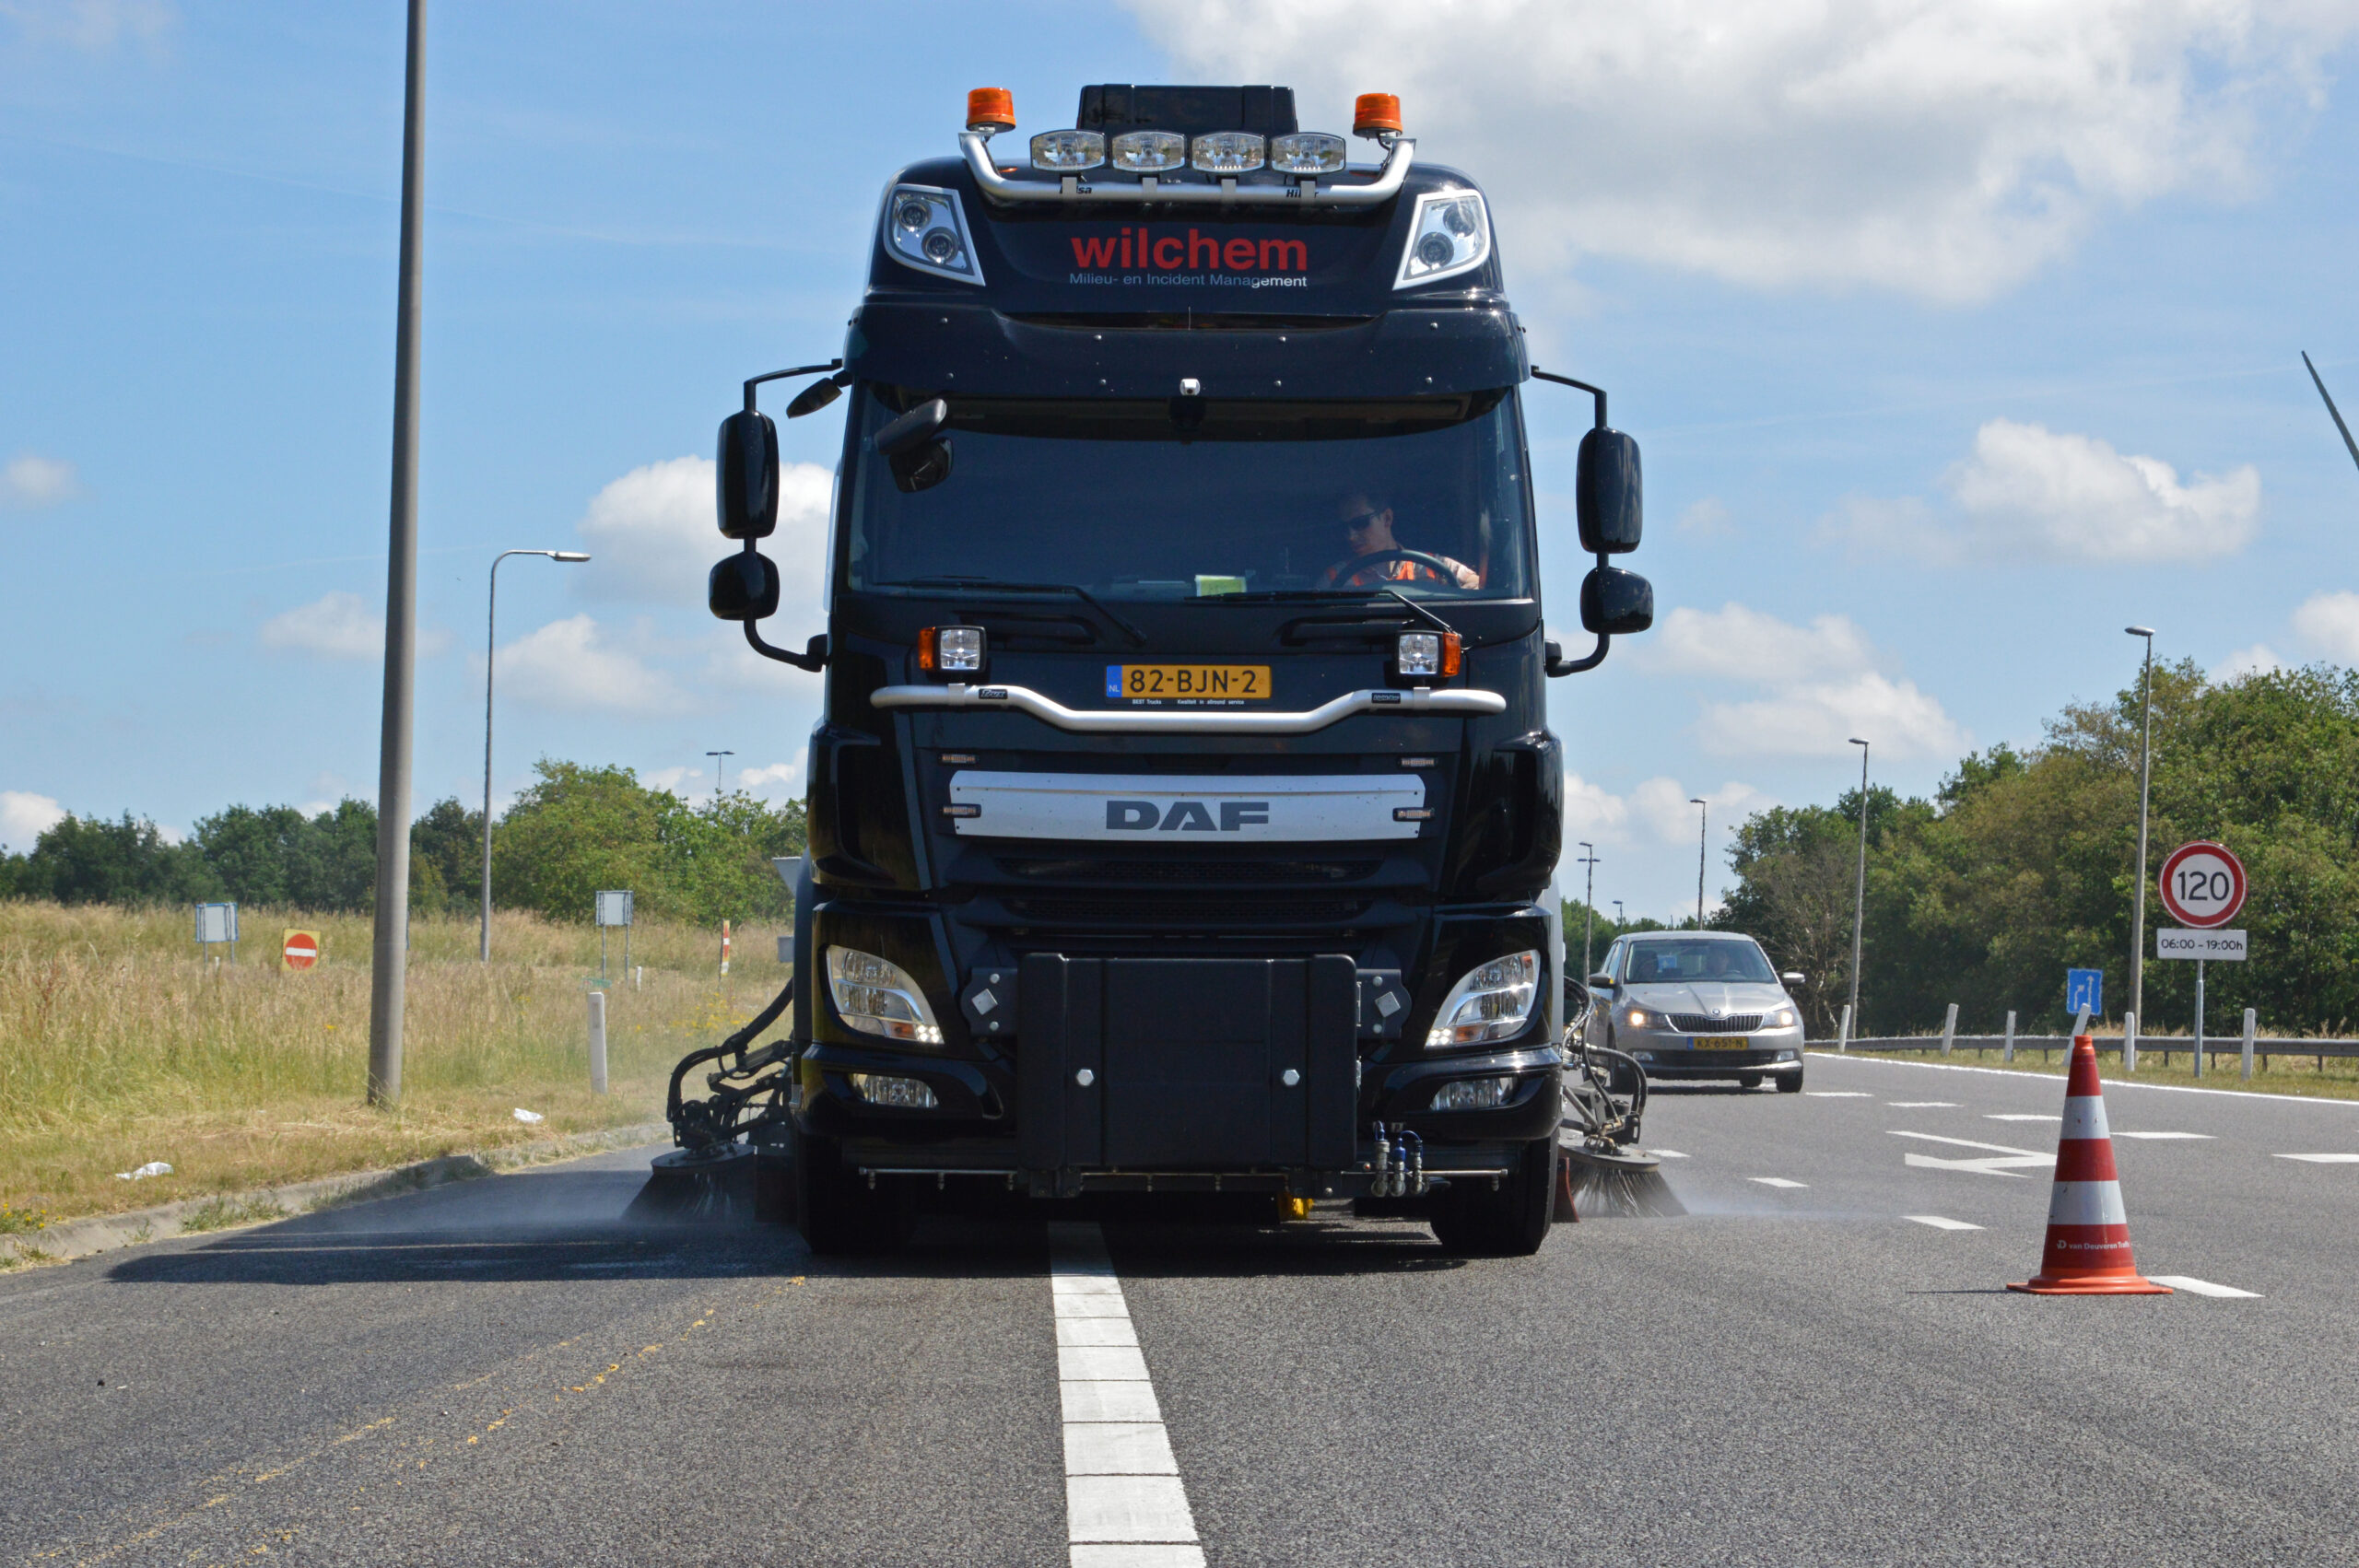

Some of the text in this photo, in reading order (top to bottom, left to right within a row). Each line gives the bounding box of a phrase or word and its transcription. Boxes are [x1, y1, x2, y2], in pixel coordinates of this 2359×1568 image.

[1071, 227, 1307, 271] wilchem
[1070, 273, 1308, 288] Milieu- en Incident Management
[1109, 669, 1257, 693] NL 82-BJN-2
[1107, 801, 1269, 831] DAF
[2177, 871, 2229, 901] 120
[2161, 939, 2195, 950] 06:00
[2206, 940, 2243, 950] 19:00h
